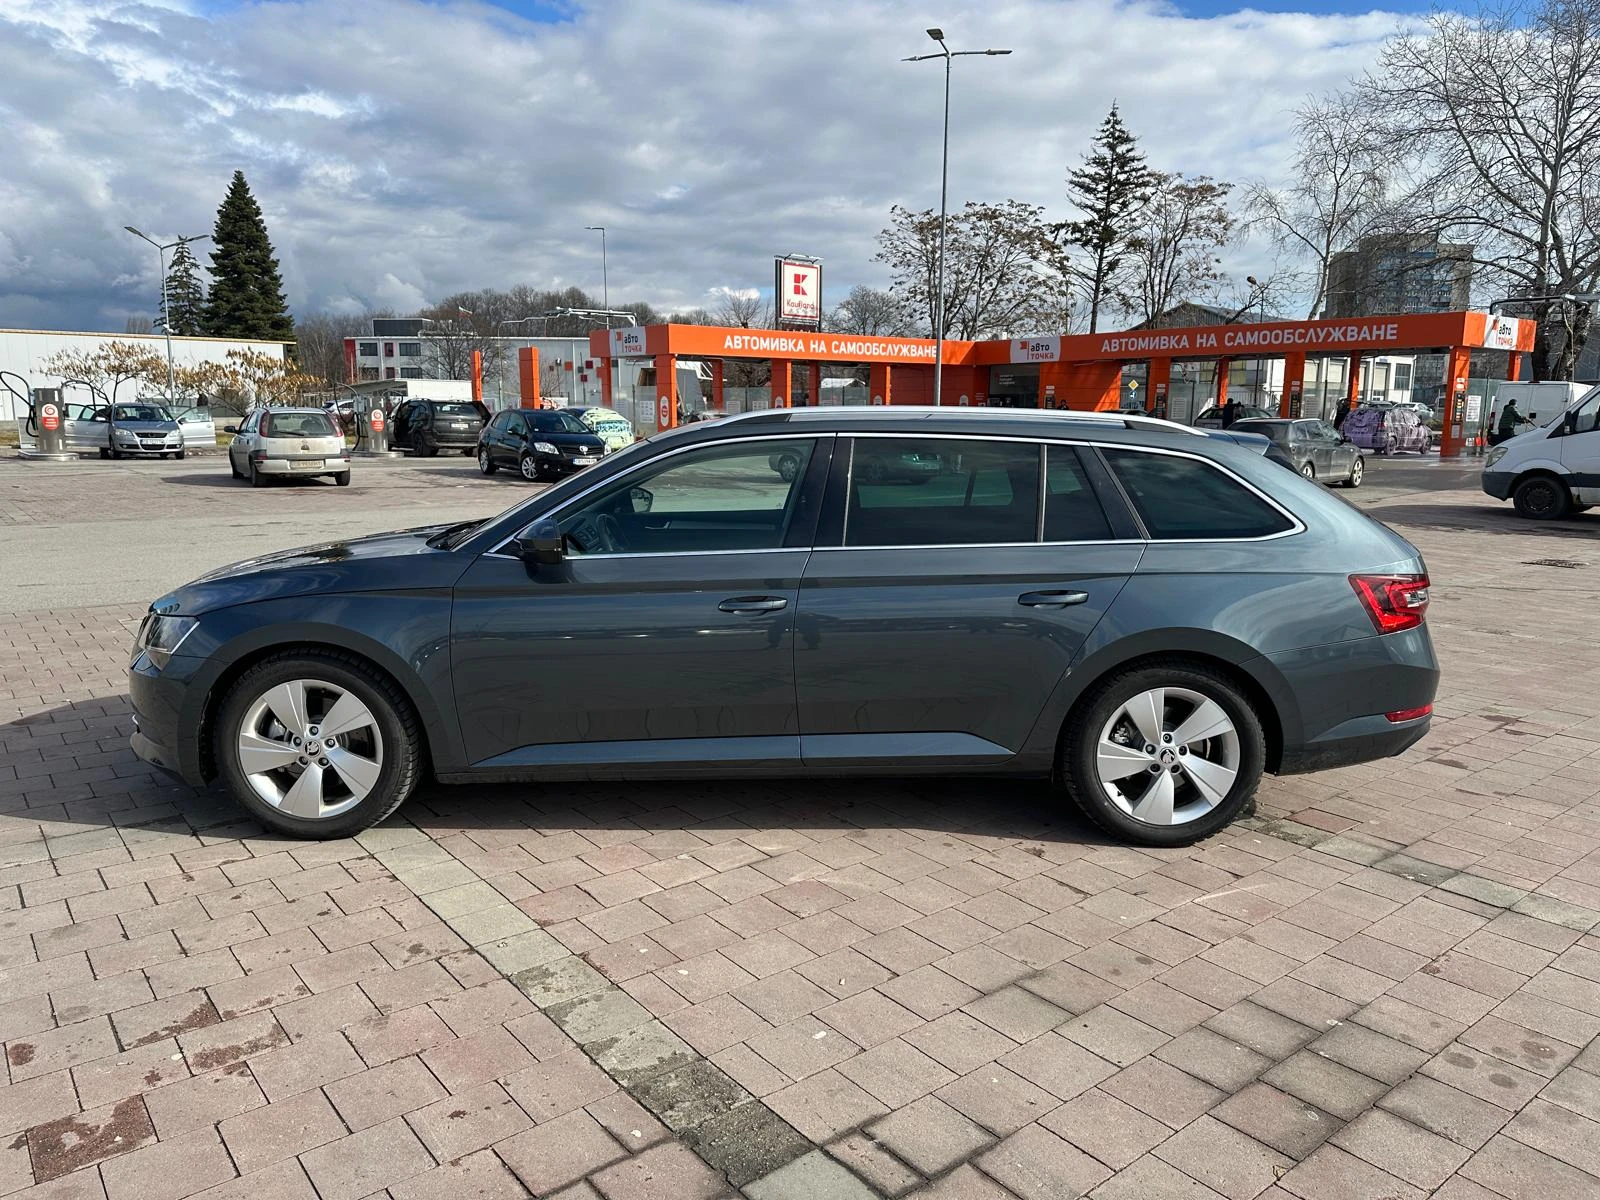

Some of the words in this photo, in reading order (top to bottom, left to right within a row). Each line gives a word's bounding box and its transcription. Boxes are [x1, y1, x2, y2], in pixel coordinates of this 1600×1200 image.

[786, 298, 816, 310] Kaufland
[623, 333, 639, 344] авто
[1100, 334, 1190, 353] АВТОМИВКА
[1195, 332, 1218, 348] НА
[1223, 323, 1398, 347] САМООБСЛУЖВАНЕ
[723, 334, 806, 353] АВТОМИВКА
[809, 339, 828, 354] НА
[831, 340, 938, 358] САМООБСЛУЖВАНЕ
[1030, 342, 1050, 352] авто
